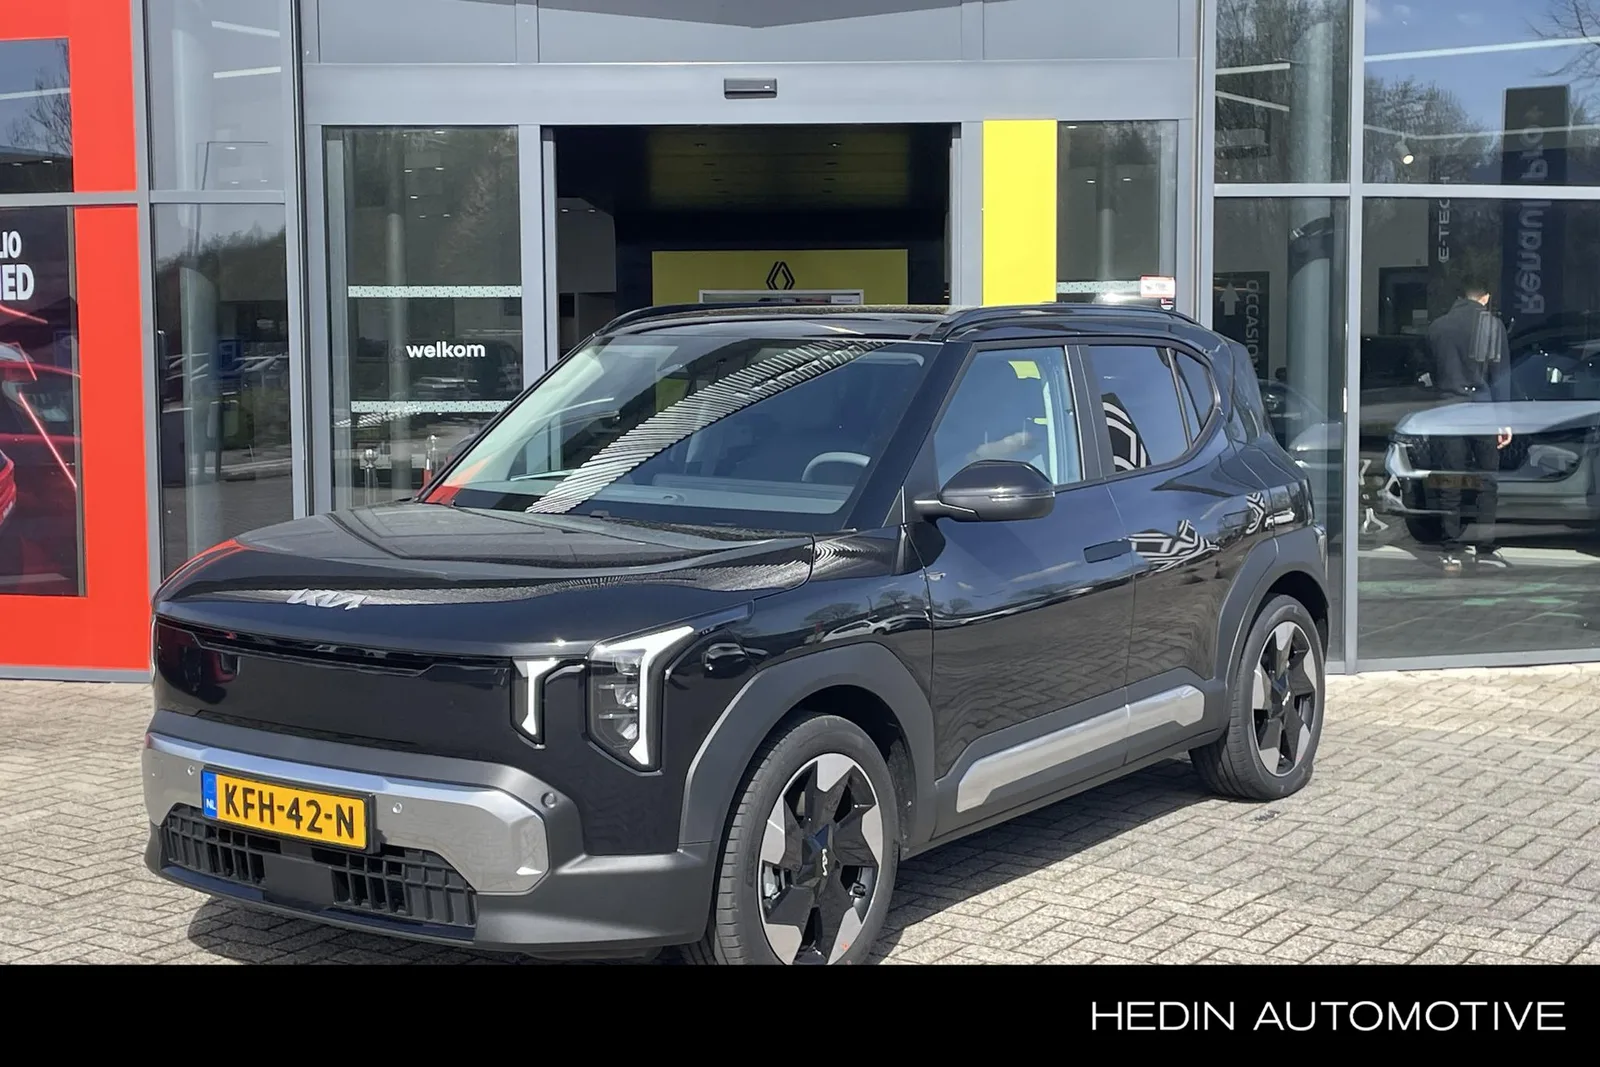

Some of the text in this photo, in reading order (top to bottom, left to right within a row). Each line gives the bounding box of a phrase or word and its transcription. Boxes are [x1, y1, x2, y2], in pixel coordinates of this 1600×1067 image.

[0, 264, 35, 301] ED
[406, 341, 486, 358] welkom
[206, 798, 217, 811] NL
[224, 782, 355, 839] KFH-42-N
